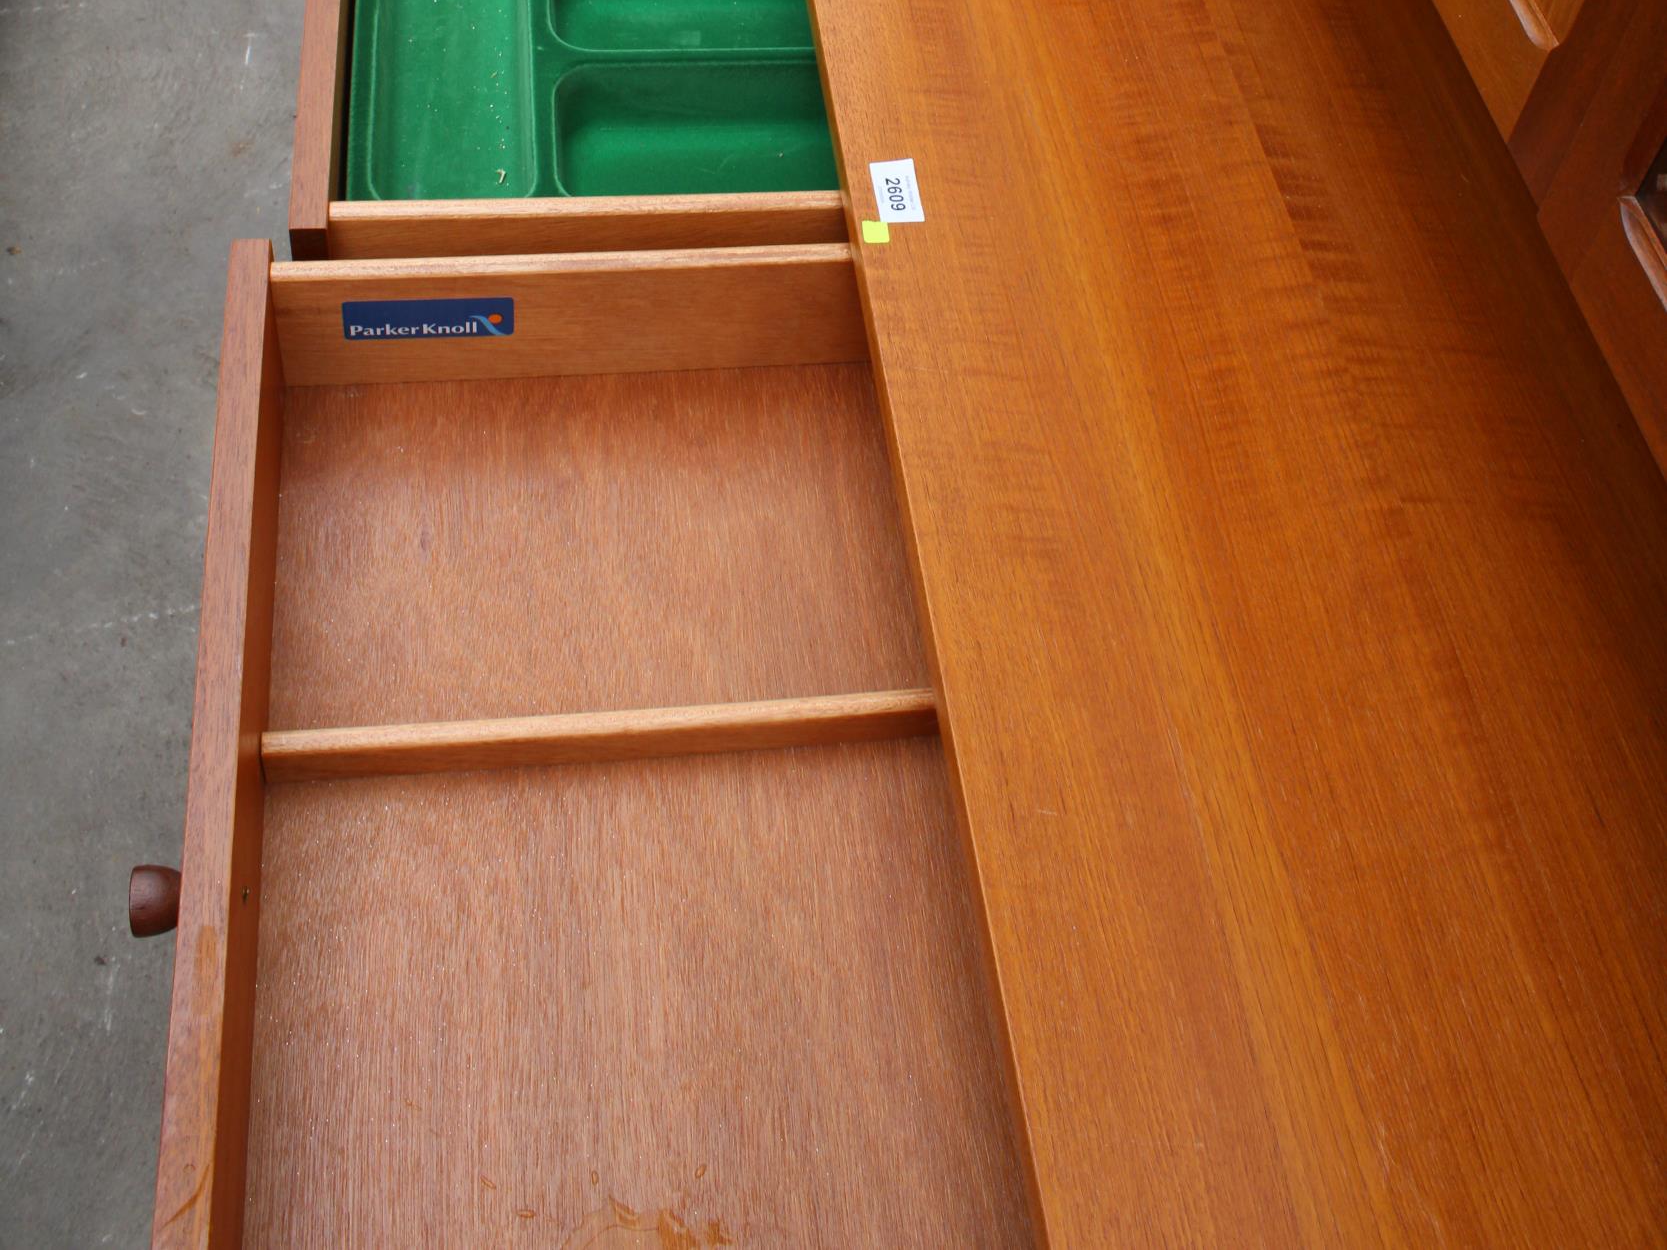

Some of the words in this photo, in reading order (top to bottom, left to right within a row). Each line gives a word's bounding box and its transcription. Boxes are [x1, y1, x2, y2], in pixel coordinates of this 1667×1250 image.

[885, 177, 906, 211] 2609
[350, 323, 419, 336] Parker
[422, 321, 478, 335] Knoll
